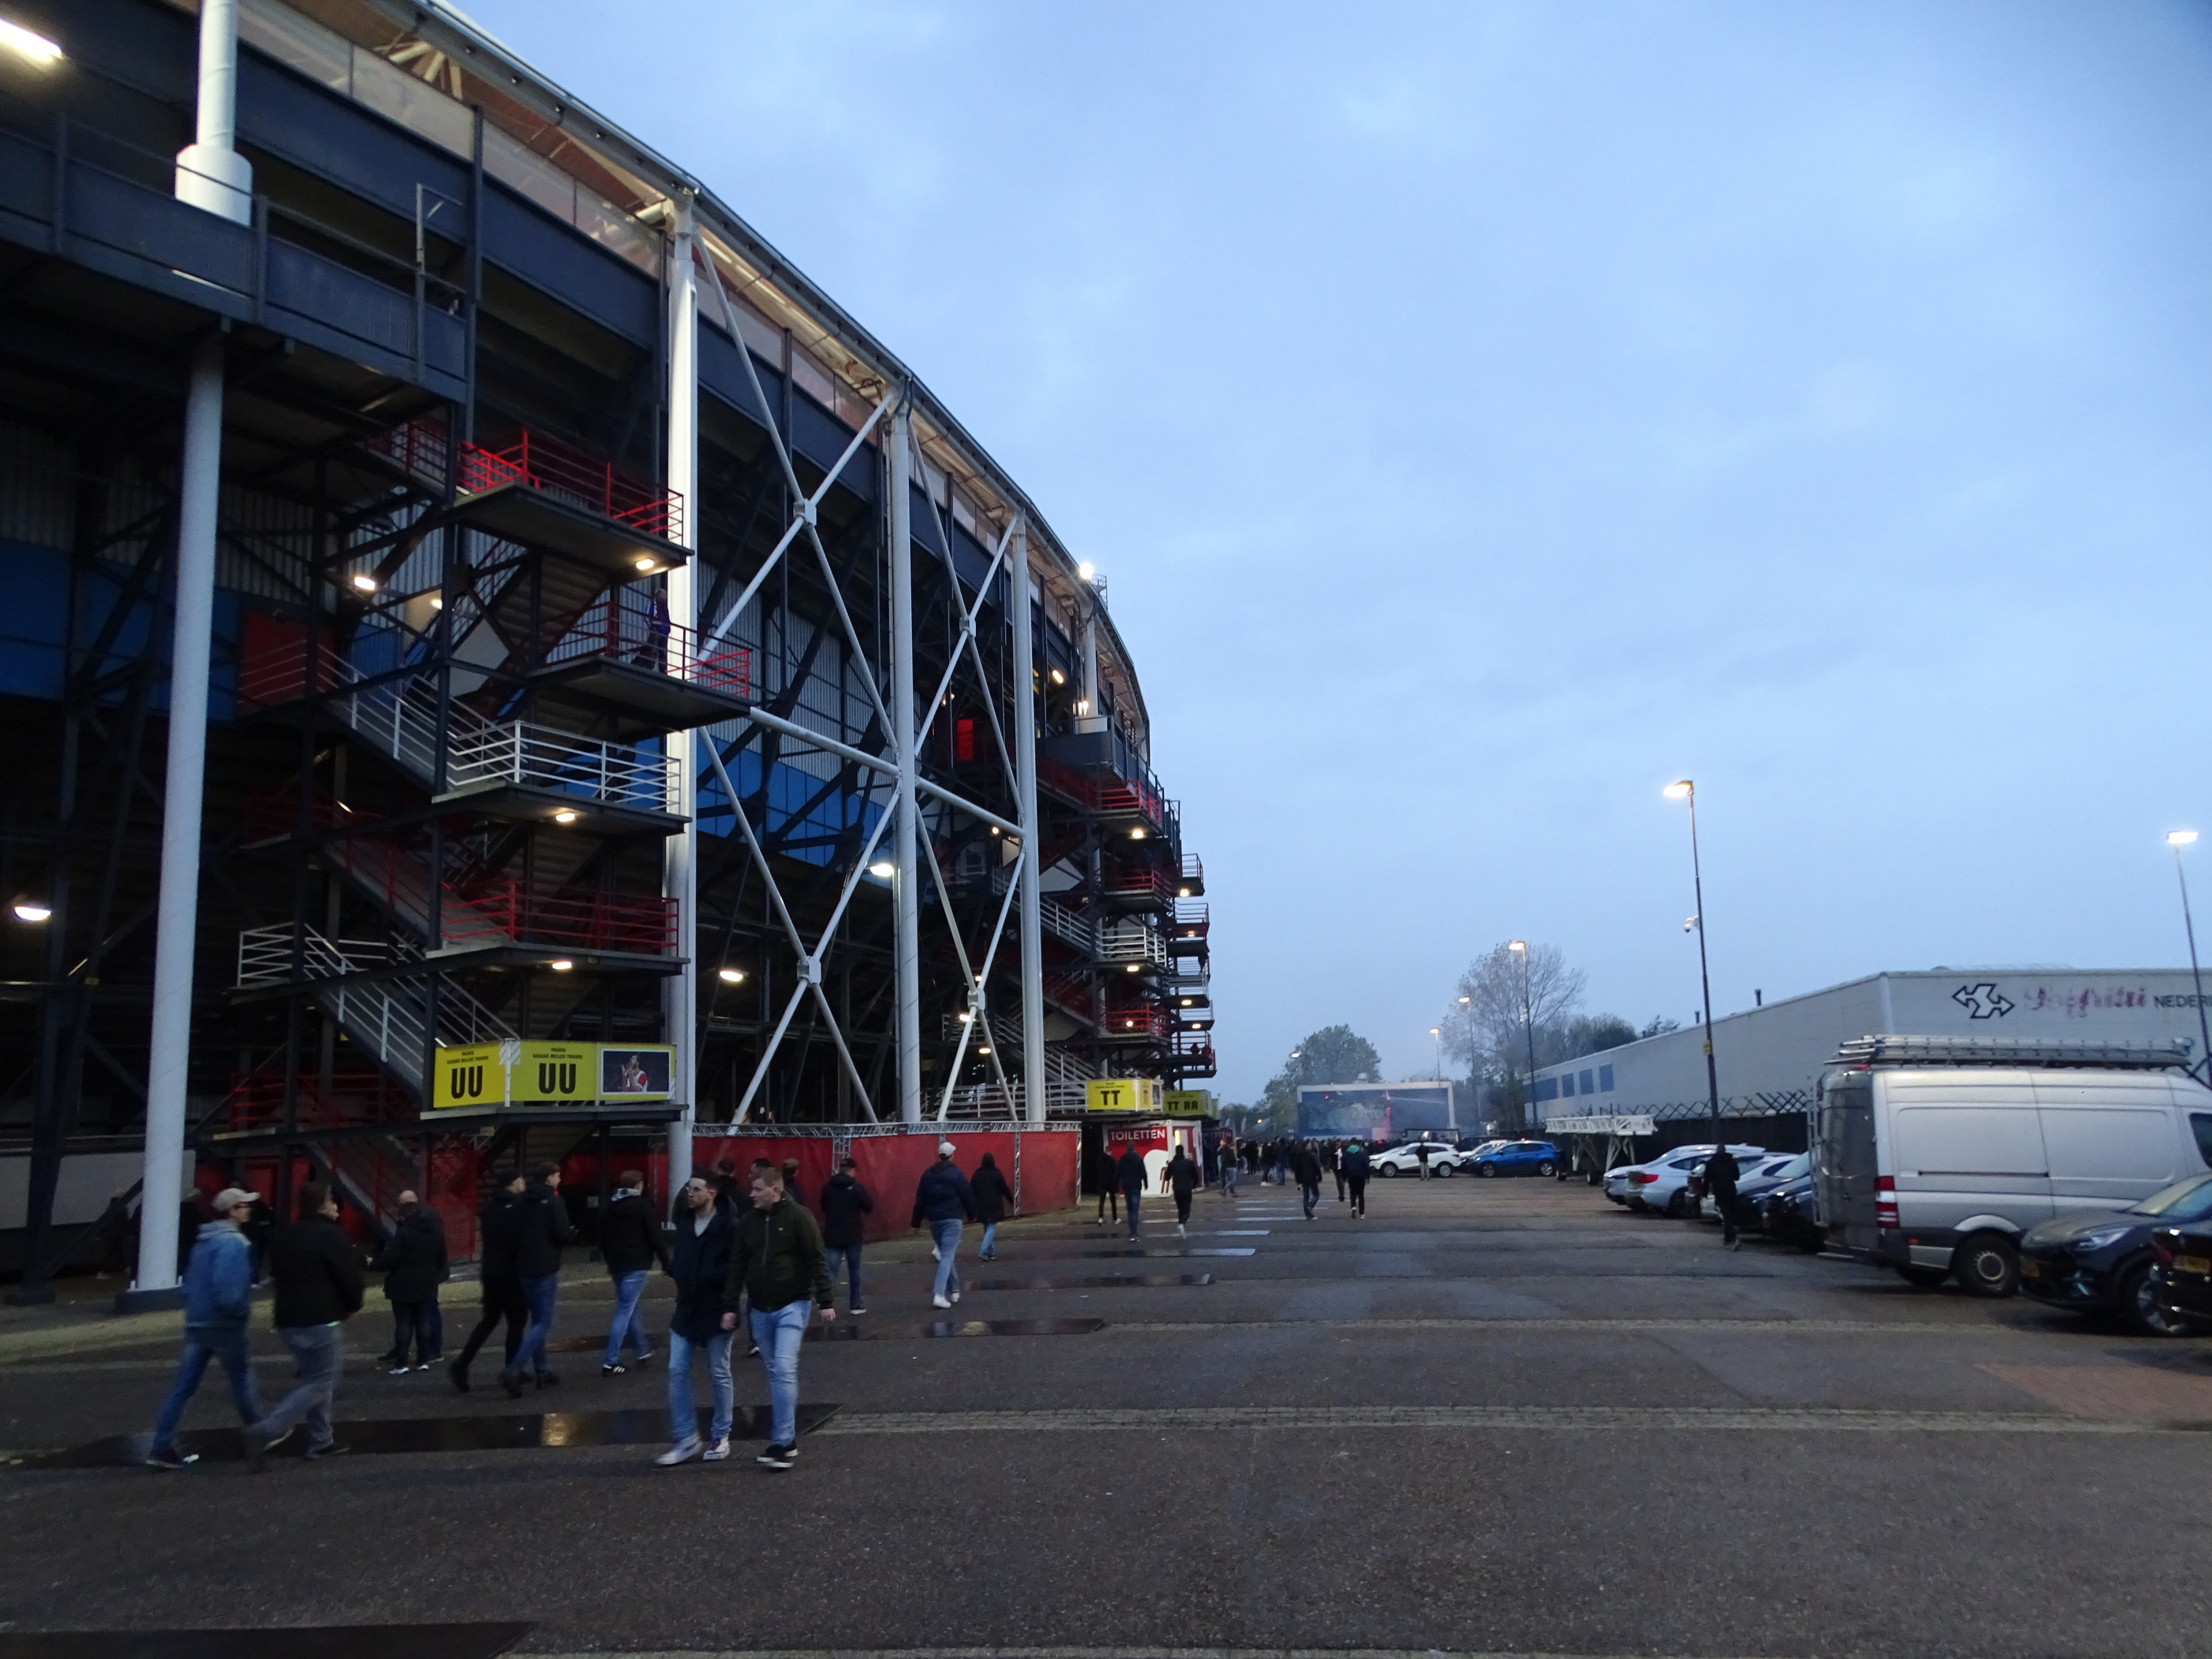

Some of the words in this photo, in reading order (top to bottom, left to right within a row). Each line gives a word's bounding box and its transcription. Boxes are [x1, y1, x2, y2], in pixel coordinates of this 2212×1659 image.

[2153, 995, 2212, 1009] NEDER
[451, 1066, 483, 1099] UU
[539, 1063, 577, 1094] UU
[1100, 1090, 1120, 1105] TT
[1167, 1101, 1179, 1111] TT
[1111, 1129, 1166, 1141] TOILETTEN
